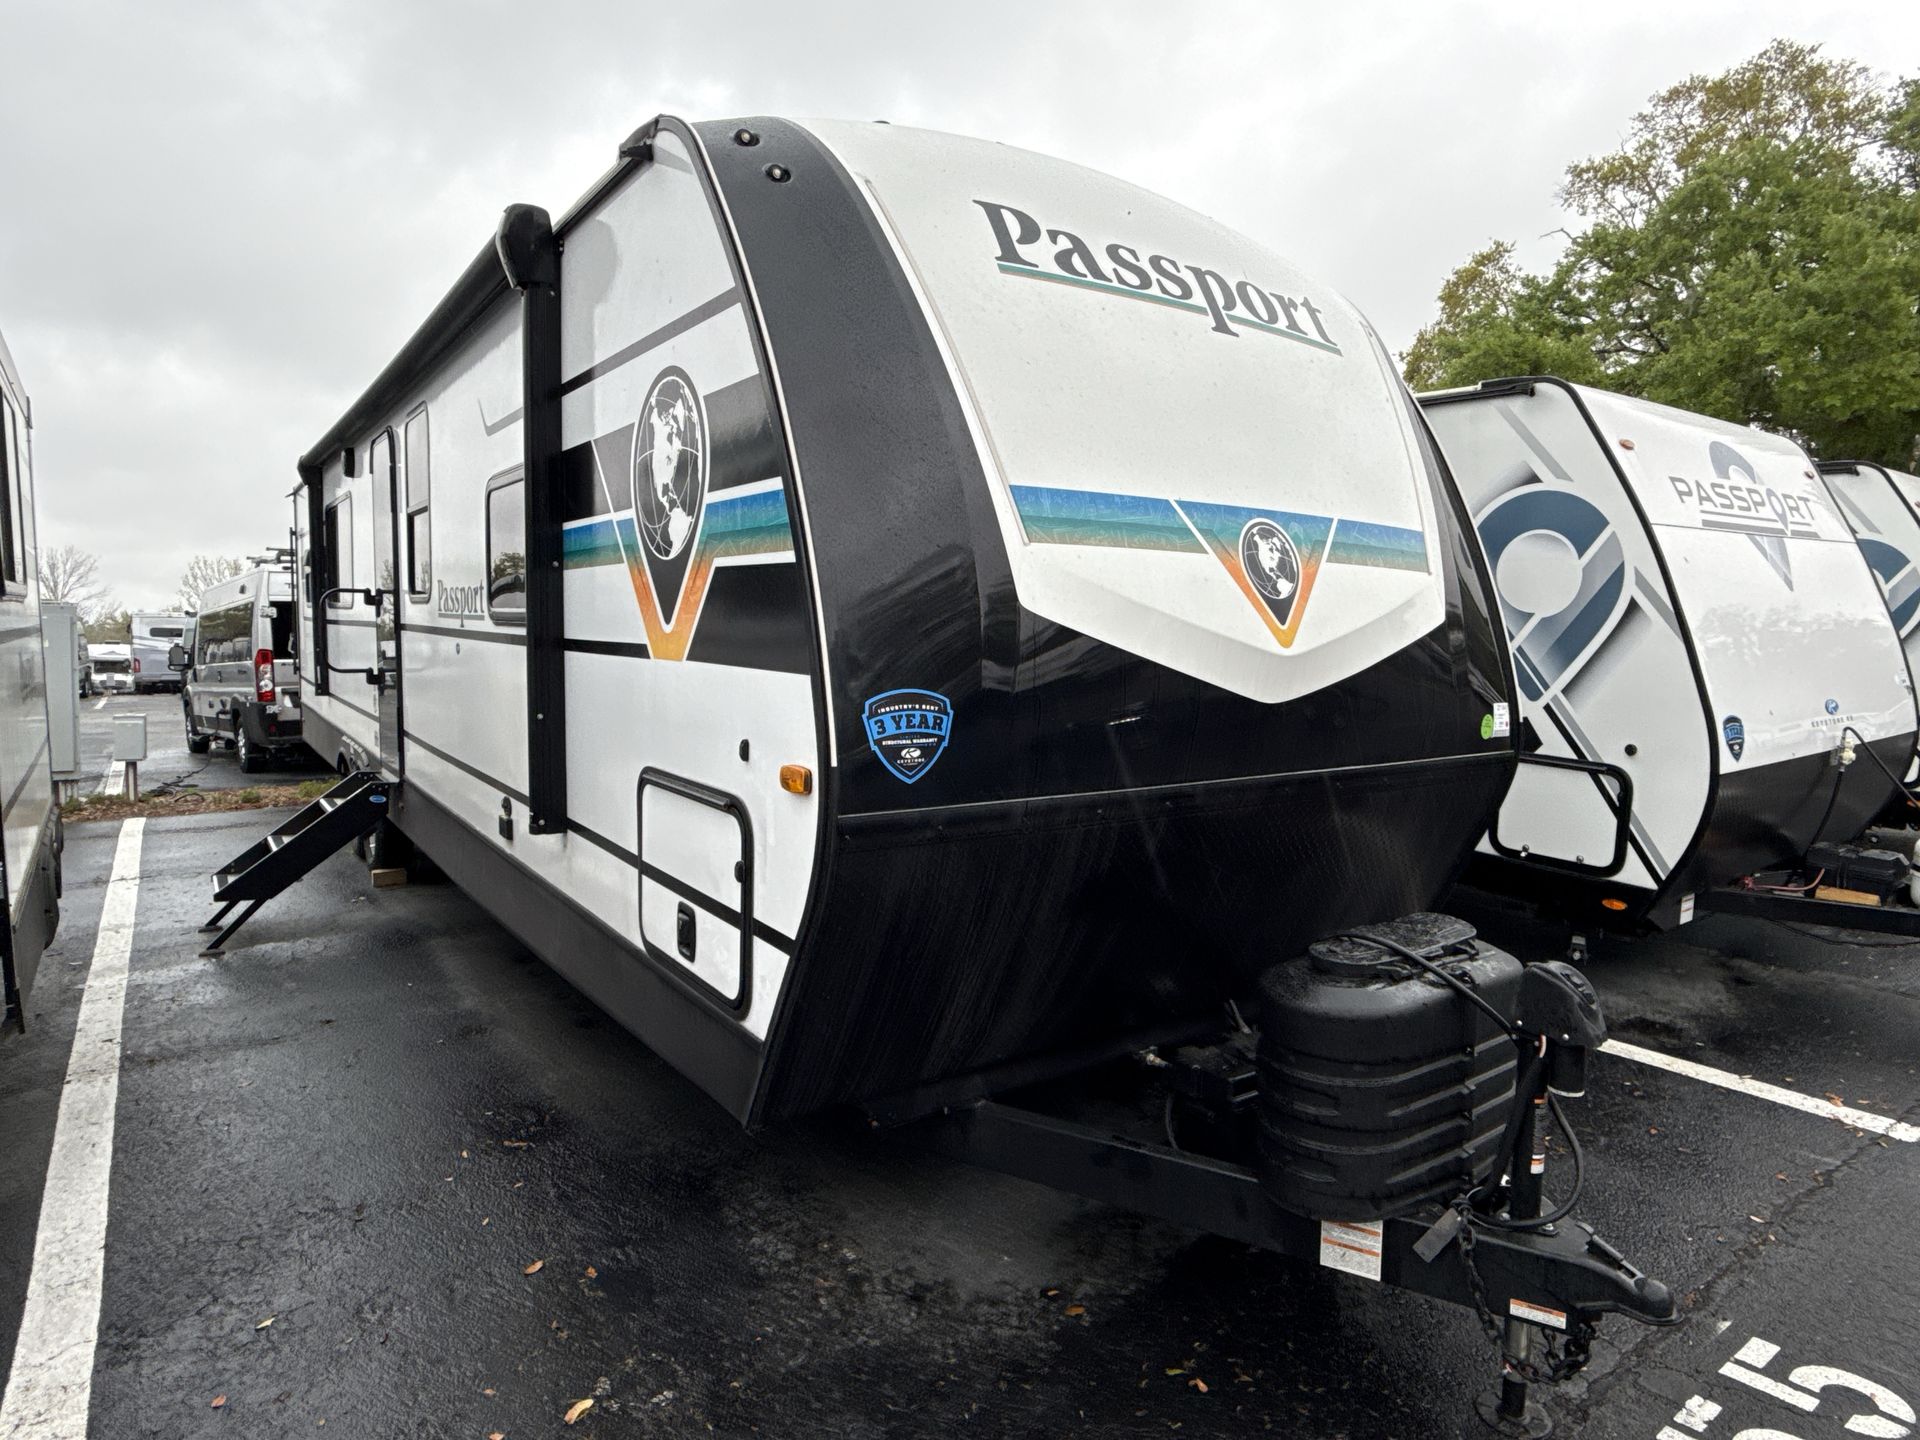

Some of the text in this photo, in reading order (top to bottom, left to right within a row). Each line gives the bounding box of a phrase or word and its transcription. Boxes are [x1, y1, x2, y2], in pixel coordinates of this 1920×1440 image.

[972, 199, 1339, 347] Passport
[1669, 476, 1815, 528] PASSPORT
[437, 579, 484, 628] Passport
[874, 713, 943, 735] 3 YEAR
